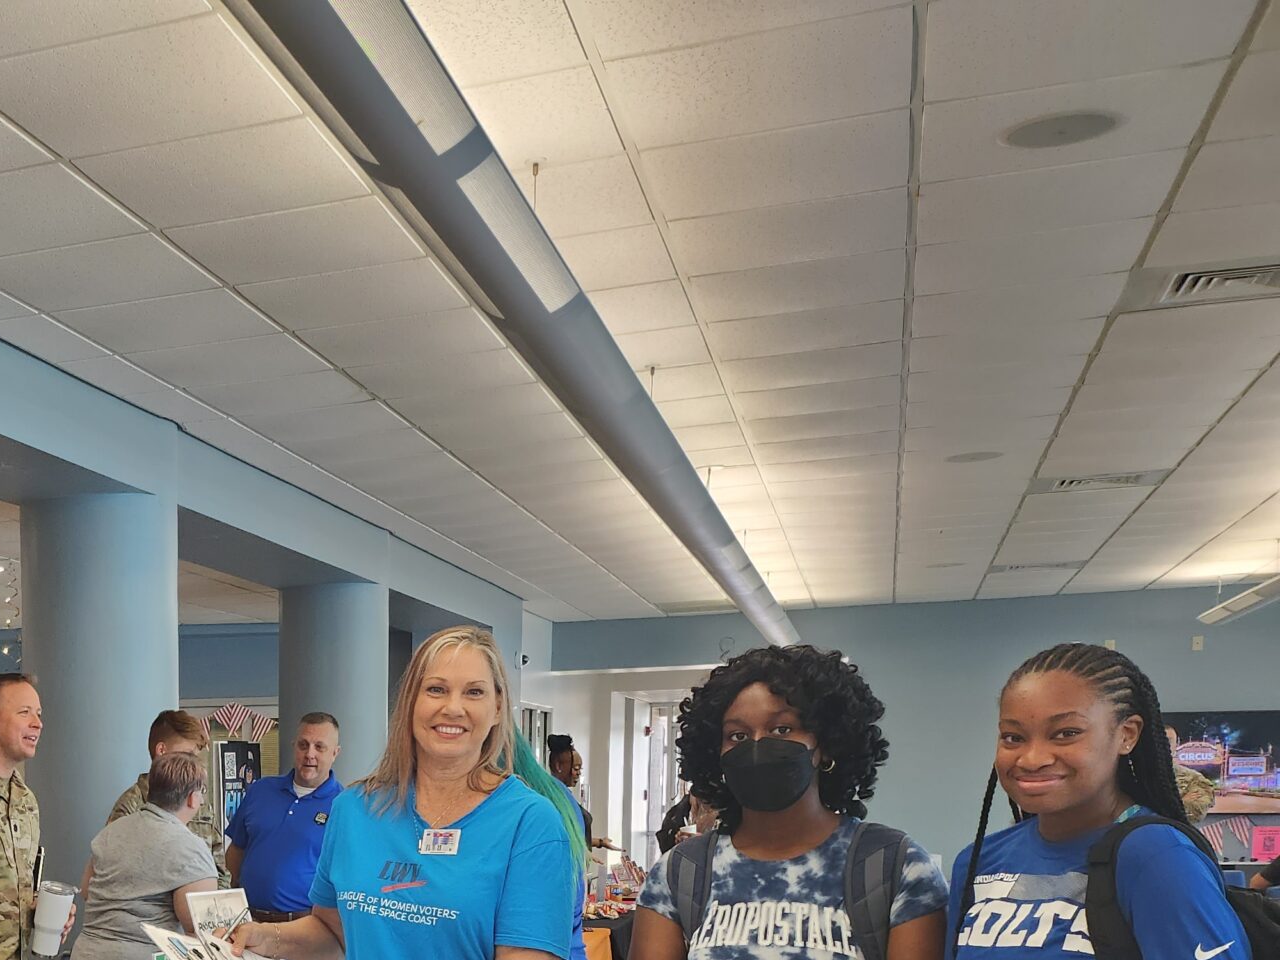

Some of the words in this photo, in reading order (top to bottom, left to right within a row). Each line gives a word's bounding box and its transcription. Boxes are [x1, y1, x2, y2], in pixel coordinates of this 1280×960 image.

[1178, 752, 1215, 761] CIRCUS
[378, 860, 424, 882] LWV
[337, 891, 366, 901] LEAGUE
[367, 896, 379, 905] OF
[380, 898, 419, 913] WOMEN
[347, 902, 358, 911] OF
[359, 903, 377, 915] THE
[378, 907, 407, 922] SPACE
[407, 914, 439, 926] COAST
[958, 900, 1095, 955] COLTS
